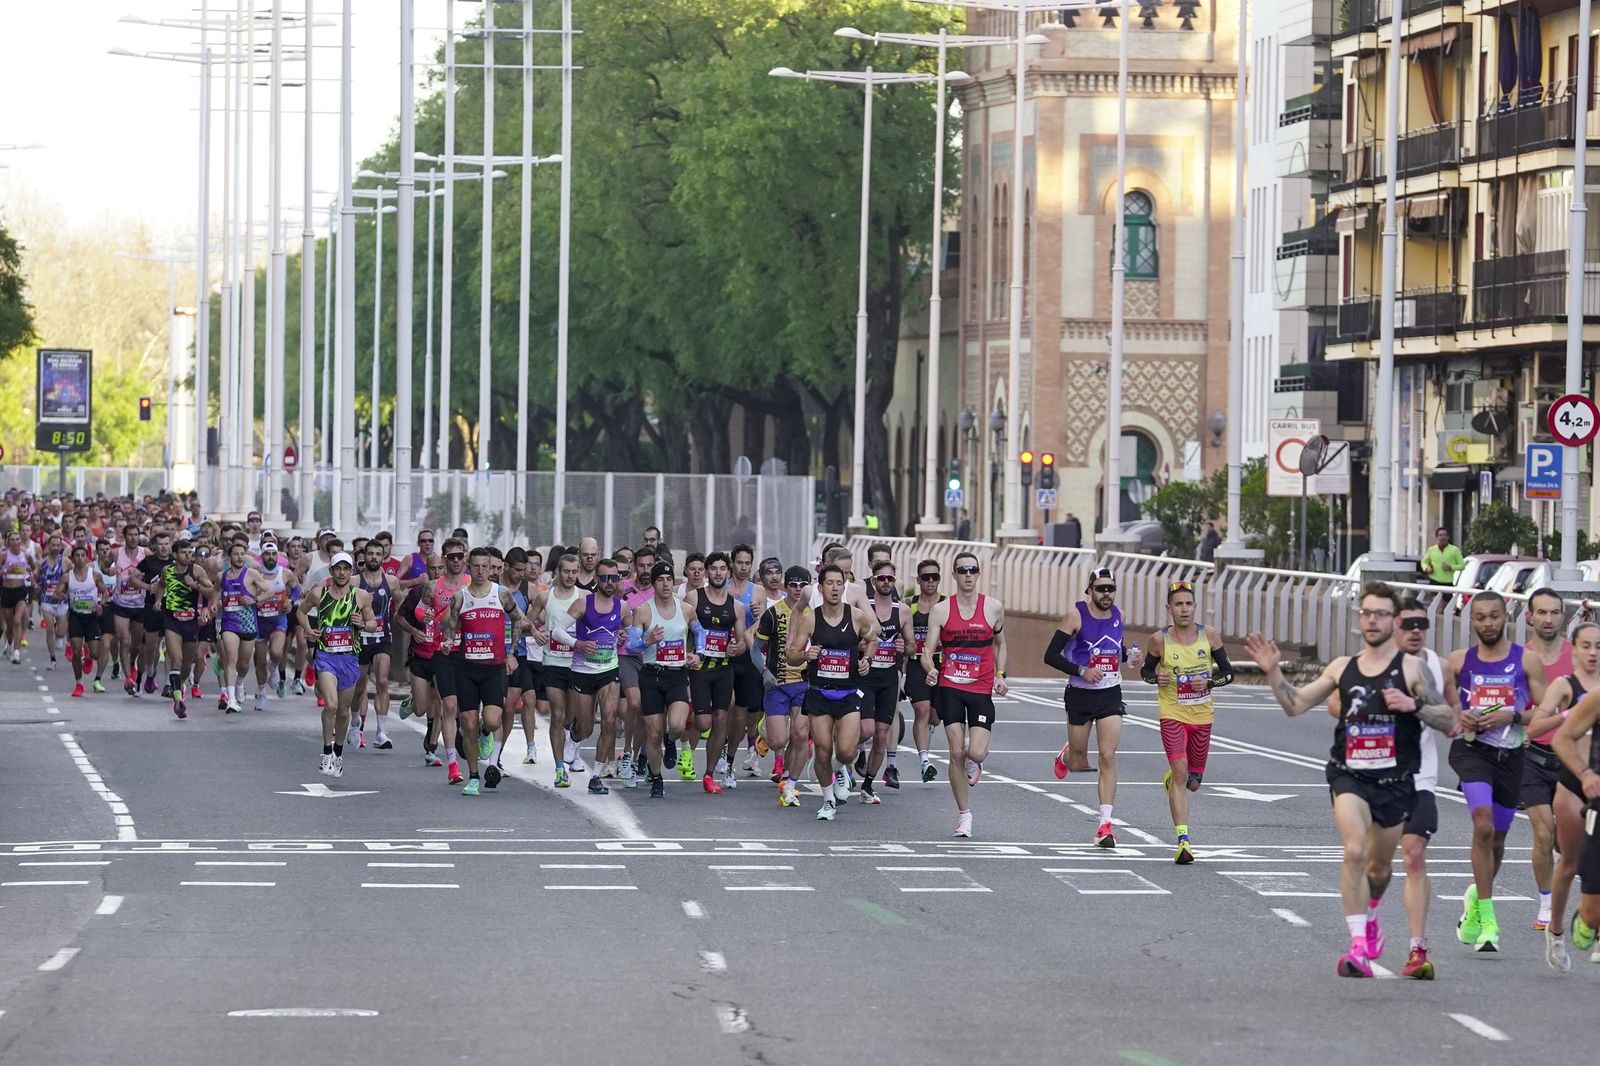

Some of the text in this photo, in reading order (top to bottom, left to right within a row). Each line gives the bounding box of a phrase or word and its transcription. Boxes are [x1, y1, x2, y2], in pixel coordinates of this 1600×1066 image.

[1272, 422, 1299, 430] CARRIL
[51, 431, 86, 446] 8:50
[1531, 448, 1554, 478] P
[705, 643, 720, 651] PAUL
[820, 664, 847, 673] QUENTIN
[953, 669, 971, 678] JACK
[1361, 727, 1389, 735] ZURICH
[1351, 747, 1392, 760] ANDREW
